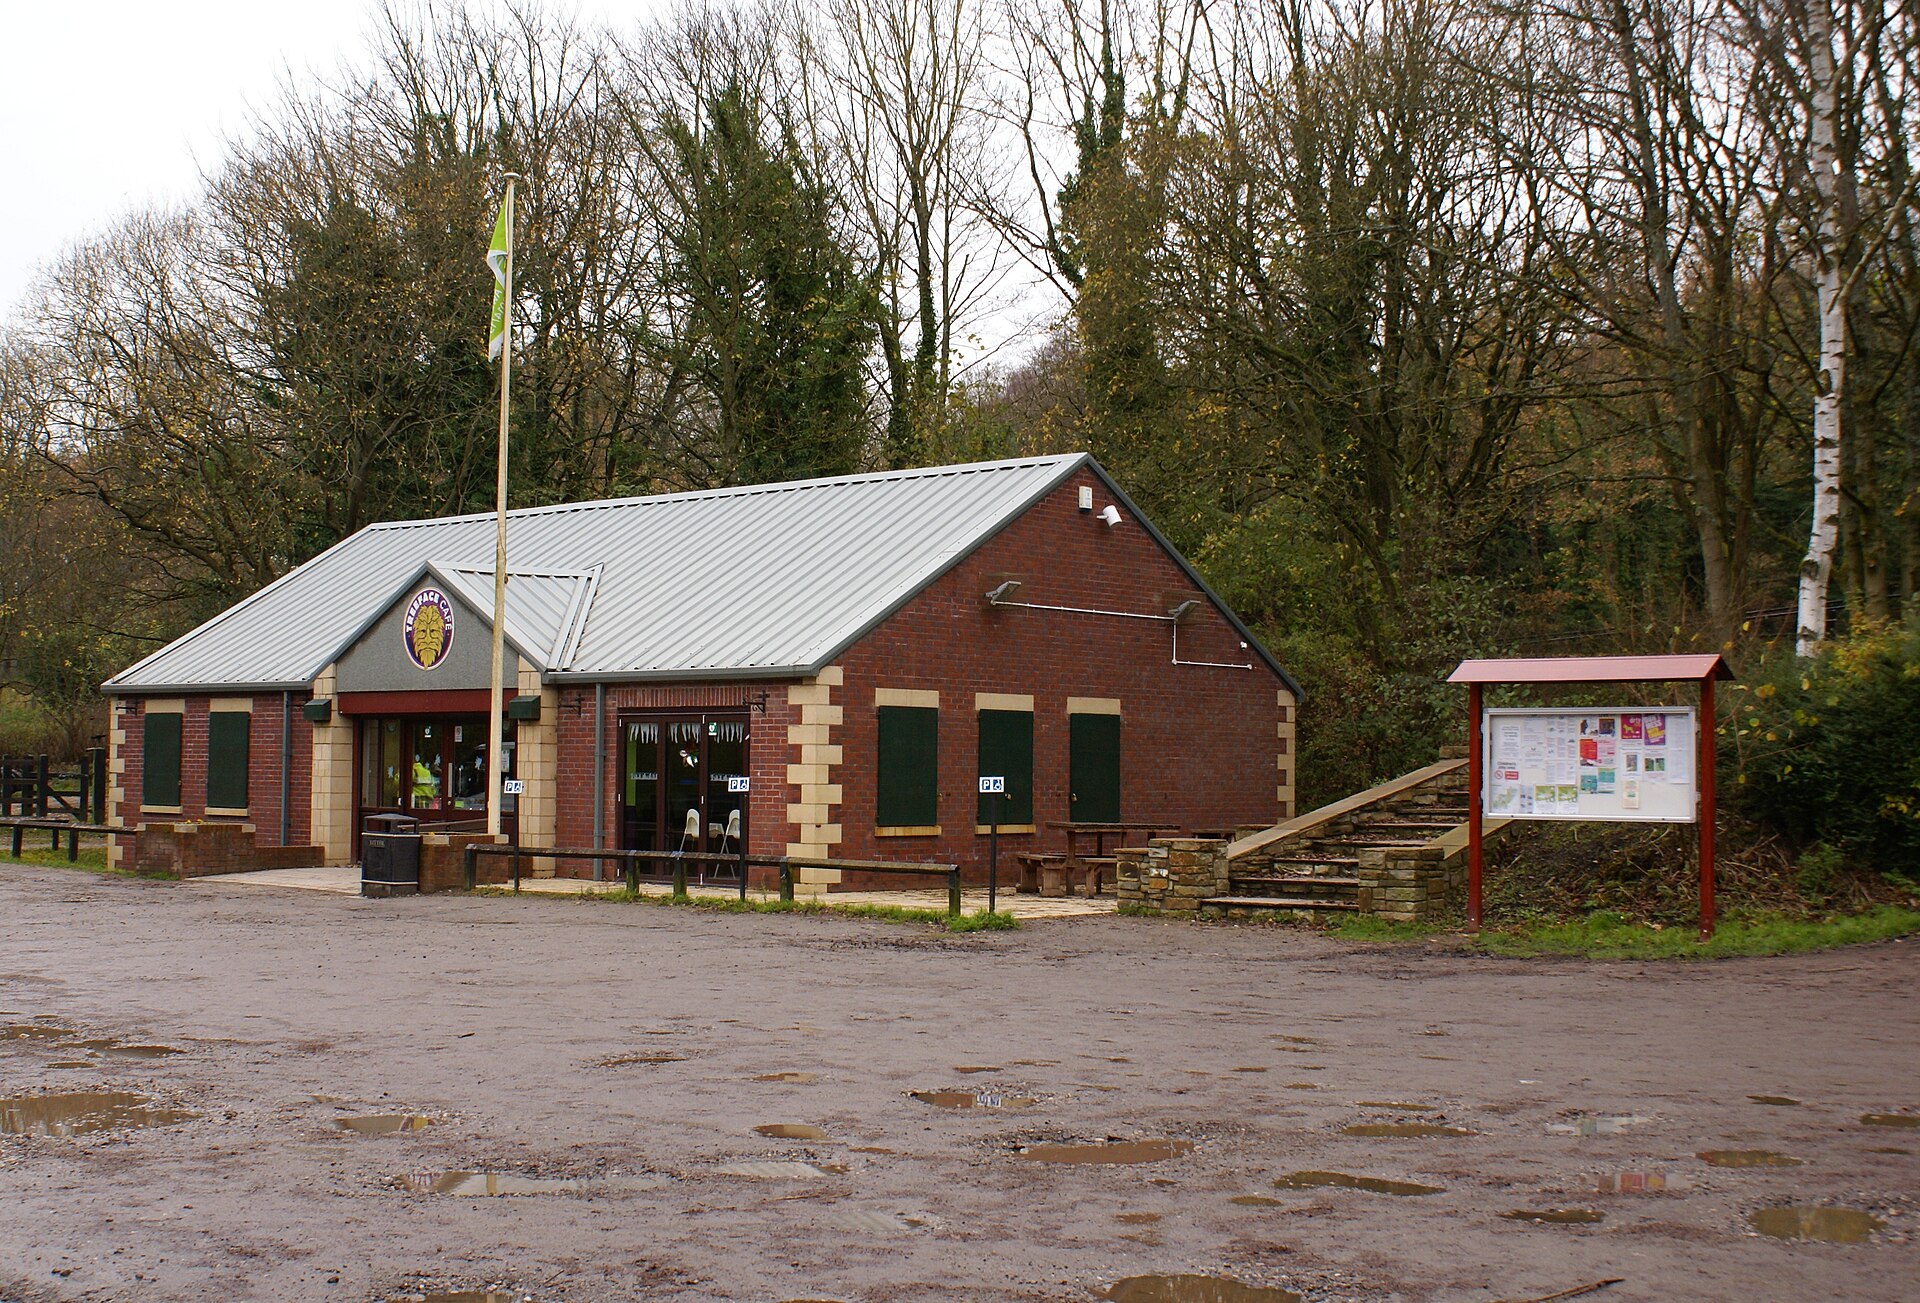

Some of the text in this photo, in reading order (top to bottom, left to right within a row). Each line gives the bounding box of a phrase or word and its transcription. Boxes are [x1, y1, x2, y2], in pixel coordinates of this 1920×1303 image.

[406, 592, 452, 633] TREEFACE CAFE
[732, 780, 737, 788] P
[984, 780, 990, 790] P
